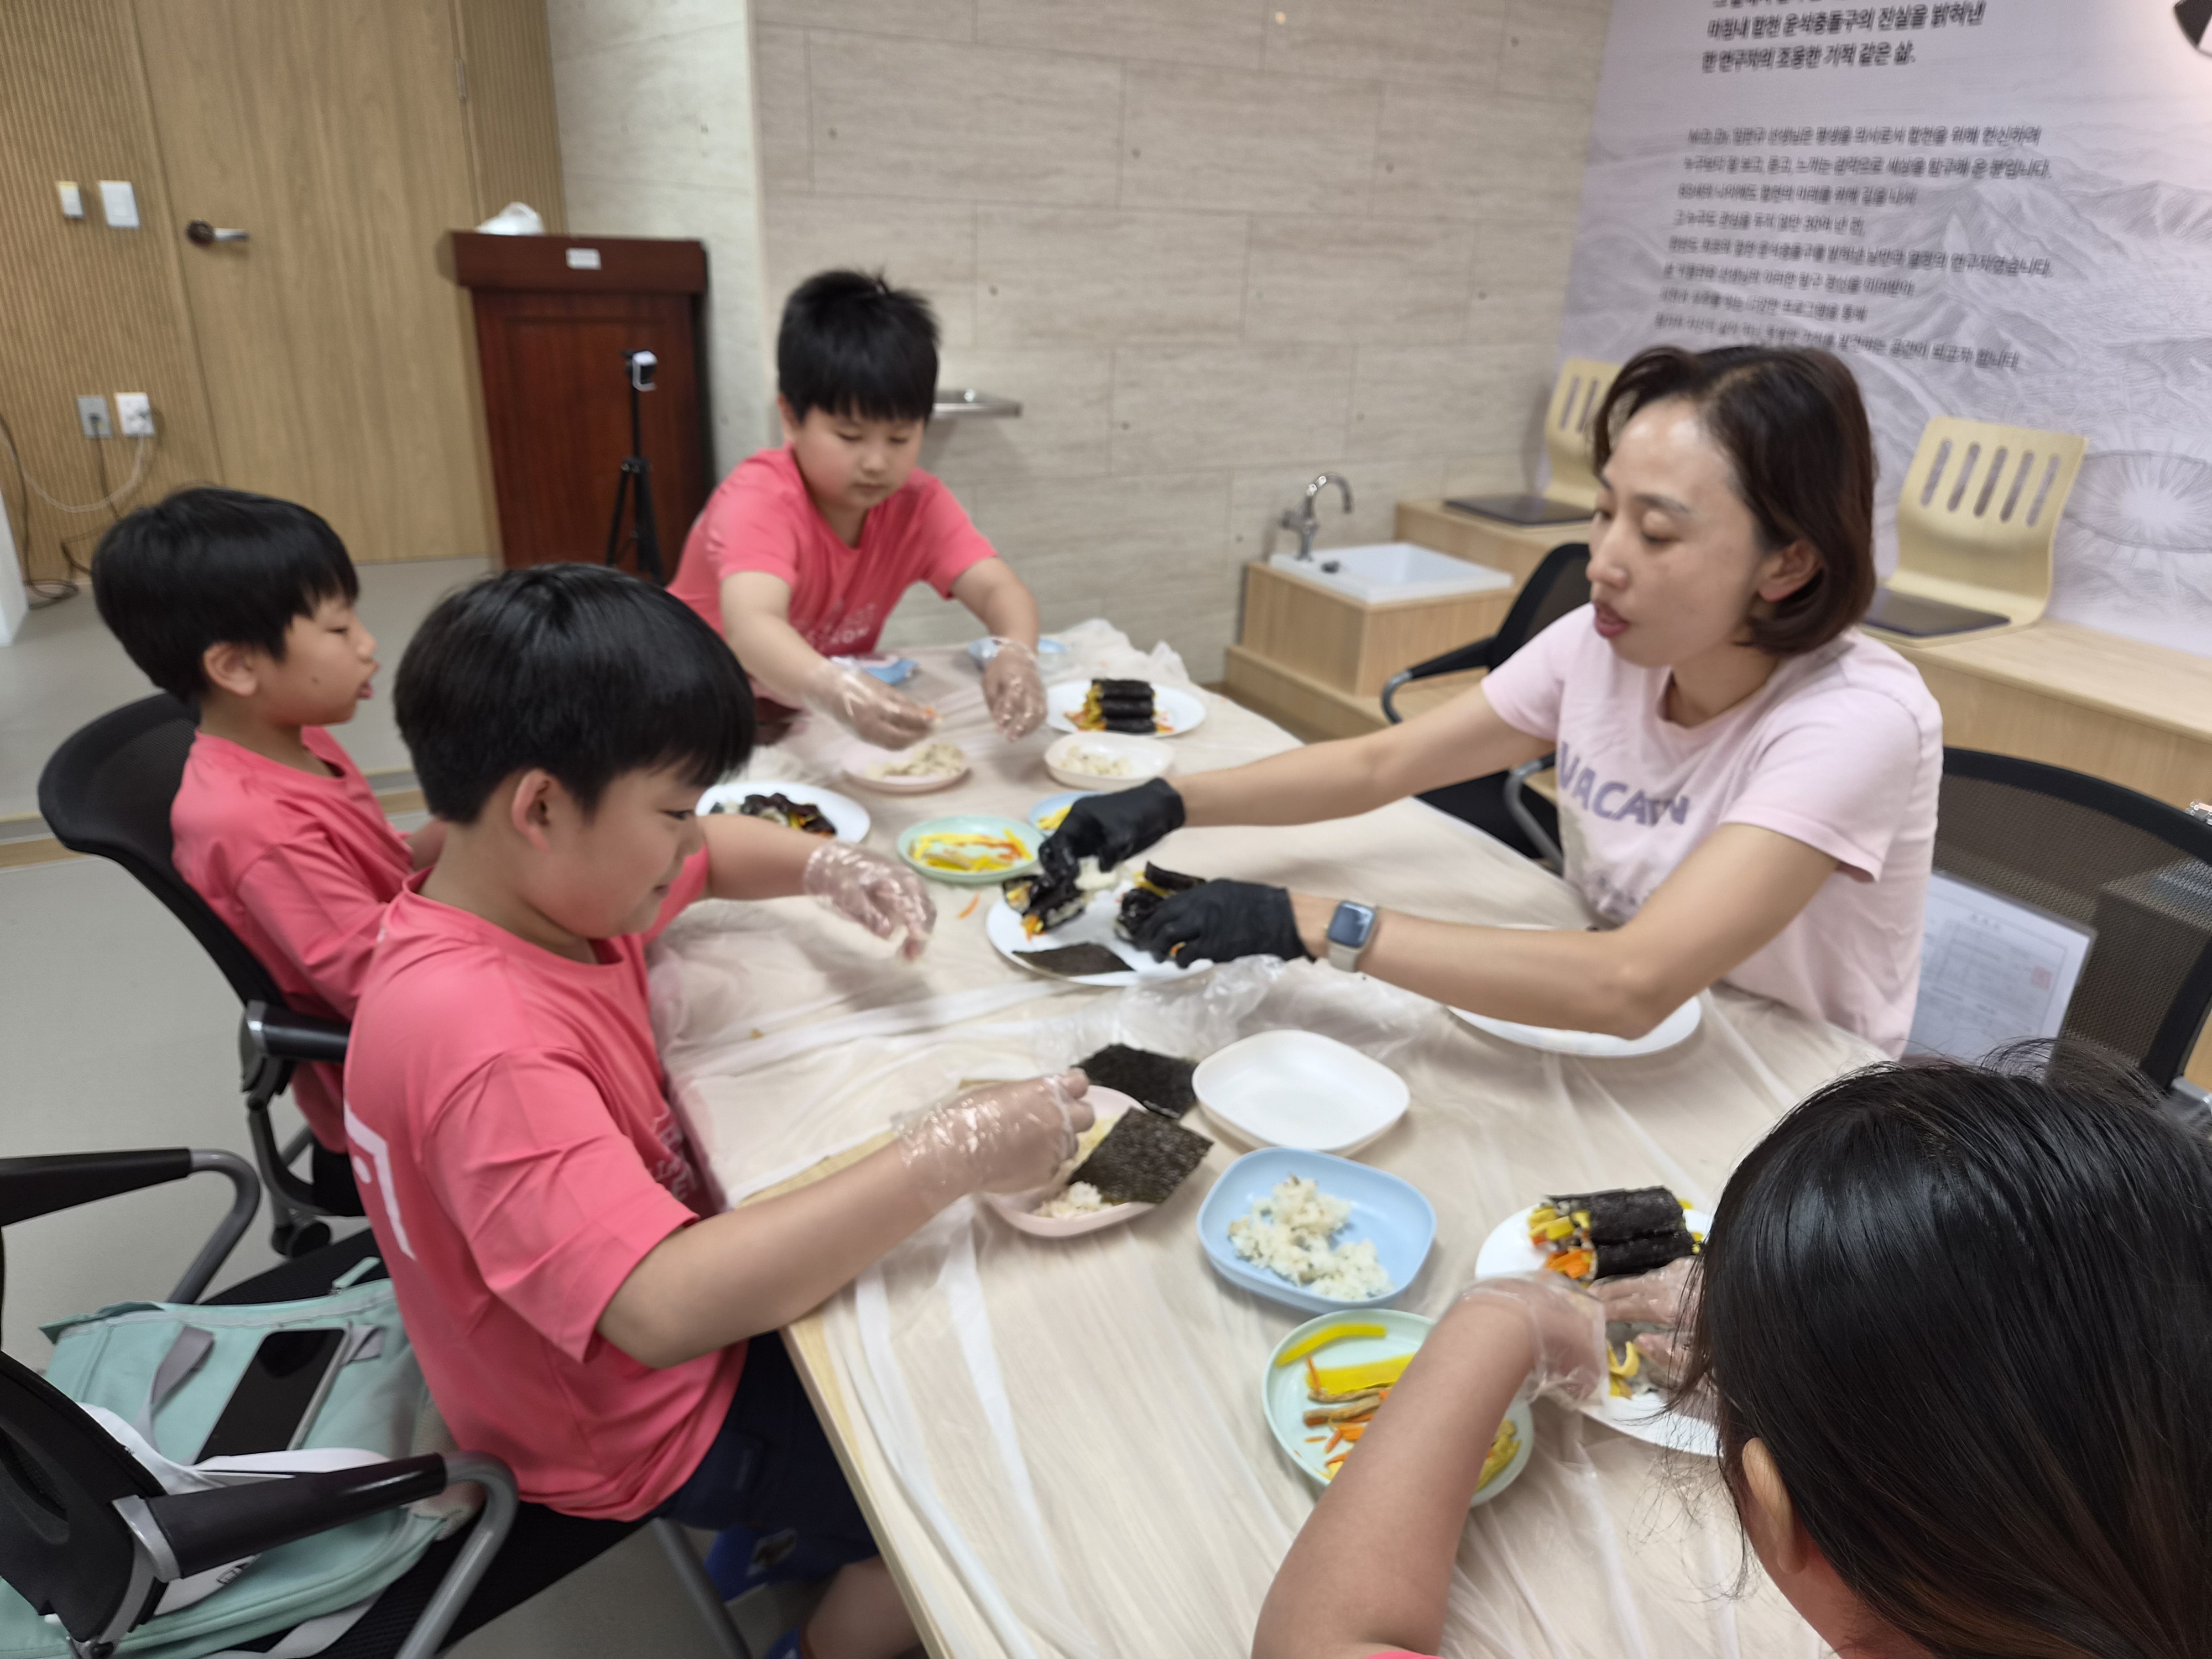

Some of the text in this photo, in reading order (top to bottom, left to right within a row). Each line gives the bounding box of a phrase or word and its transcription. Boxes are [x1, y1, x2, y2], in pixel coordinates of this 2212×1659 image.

[1877, 4, 1927, 32] 진실을
[1825, 43, 1856, 67] 기적
[1859, 41, 1892, 65] 같은
